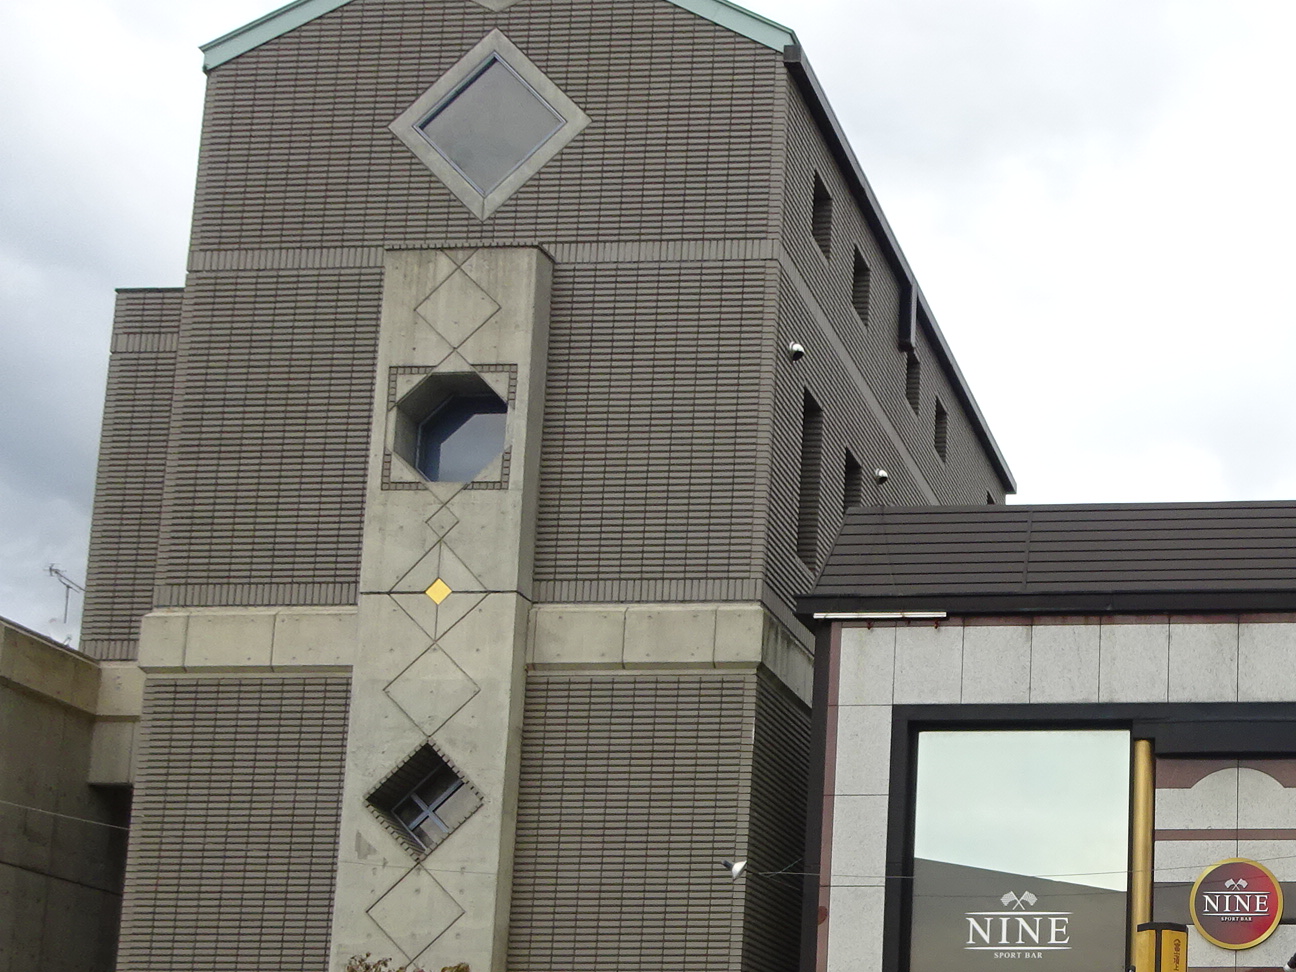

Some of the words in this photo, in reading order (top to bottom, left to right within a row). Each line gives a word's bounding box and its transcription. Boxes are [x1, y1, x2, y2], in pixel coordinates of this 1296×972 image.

[1202, 894, 1269, 912] NINE
[965, 917, 1070, 944] NINE
[993, 951, 1022, 959] SPORT
[1024, 951, 1043, 959] BAR
